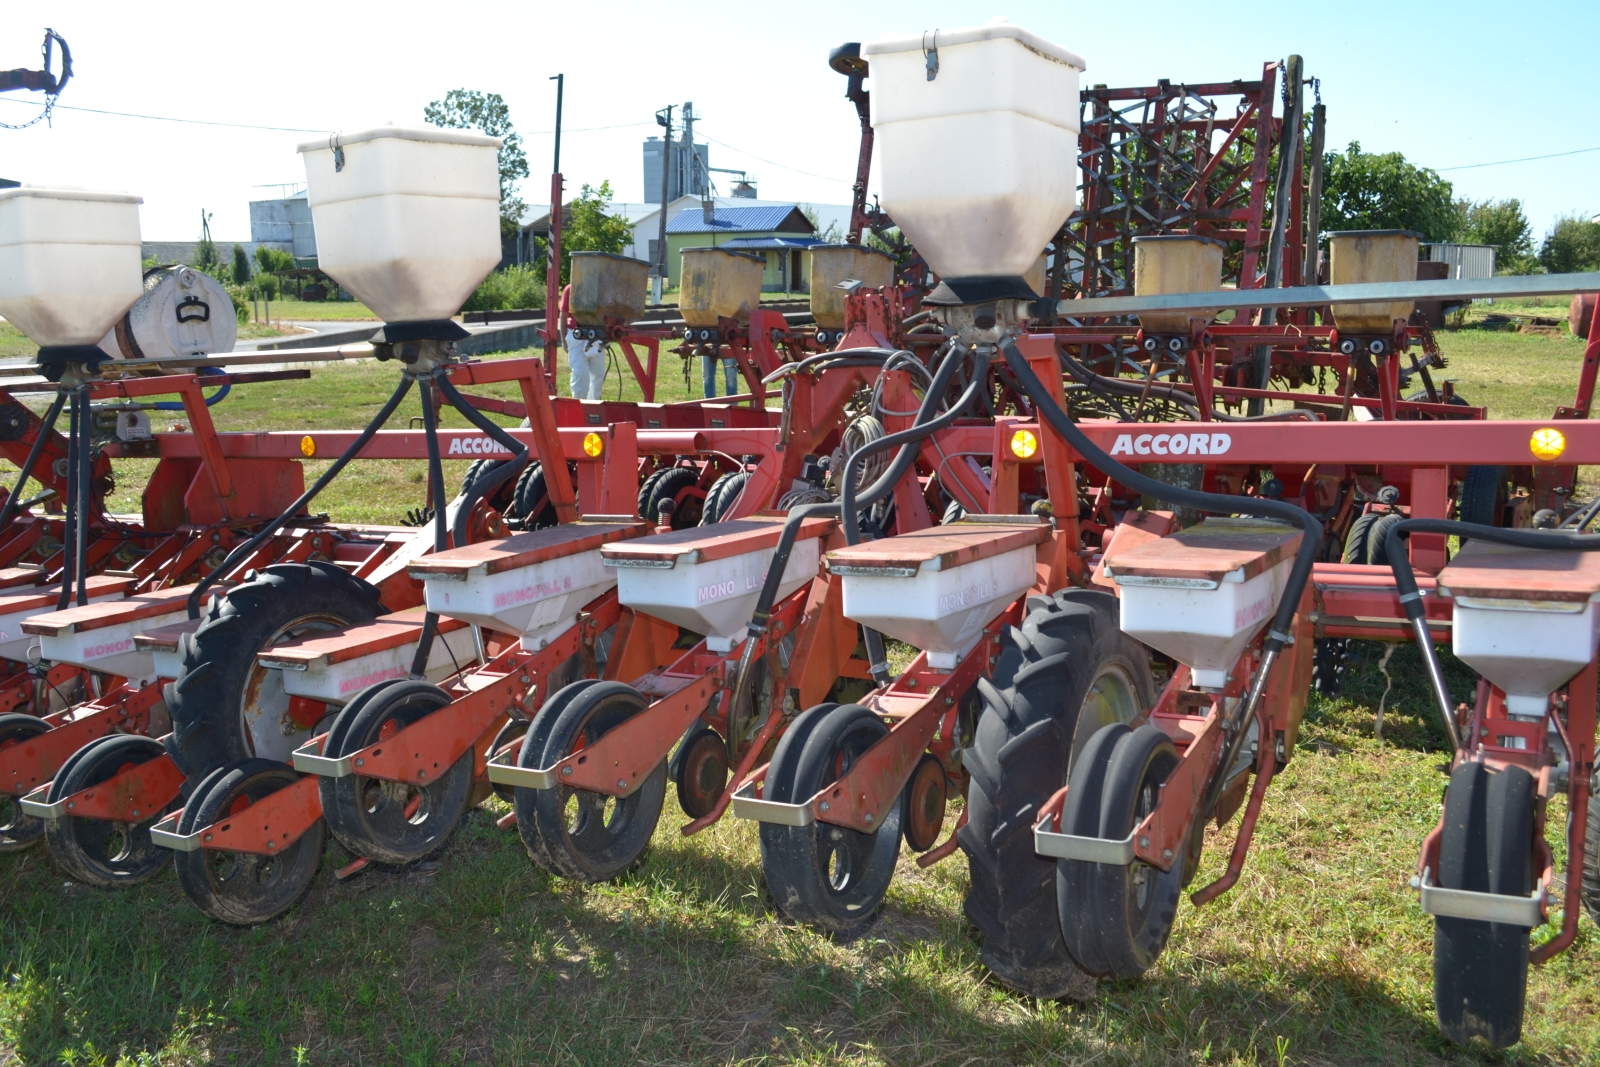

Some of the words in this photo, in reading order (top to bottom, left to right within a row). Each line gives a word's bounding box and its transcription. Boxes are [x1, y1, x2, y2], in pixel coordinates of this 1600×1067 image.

[448, 437, 513, 455] ACCOR
[1109, 433, 1232, 456] ACCORD
[494, 579, 561, 607] MONOPILL
[939, 583, 991, 612] MONOPILL
[84, 639, 133, 659] MONOP
[340, 665, 409, 694] MONOPILL
